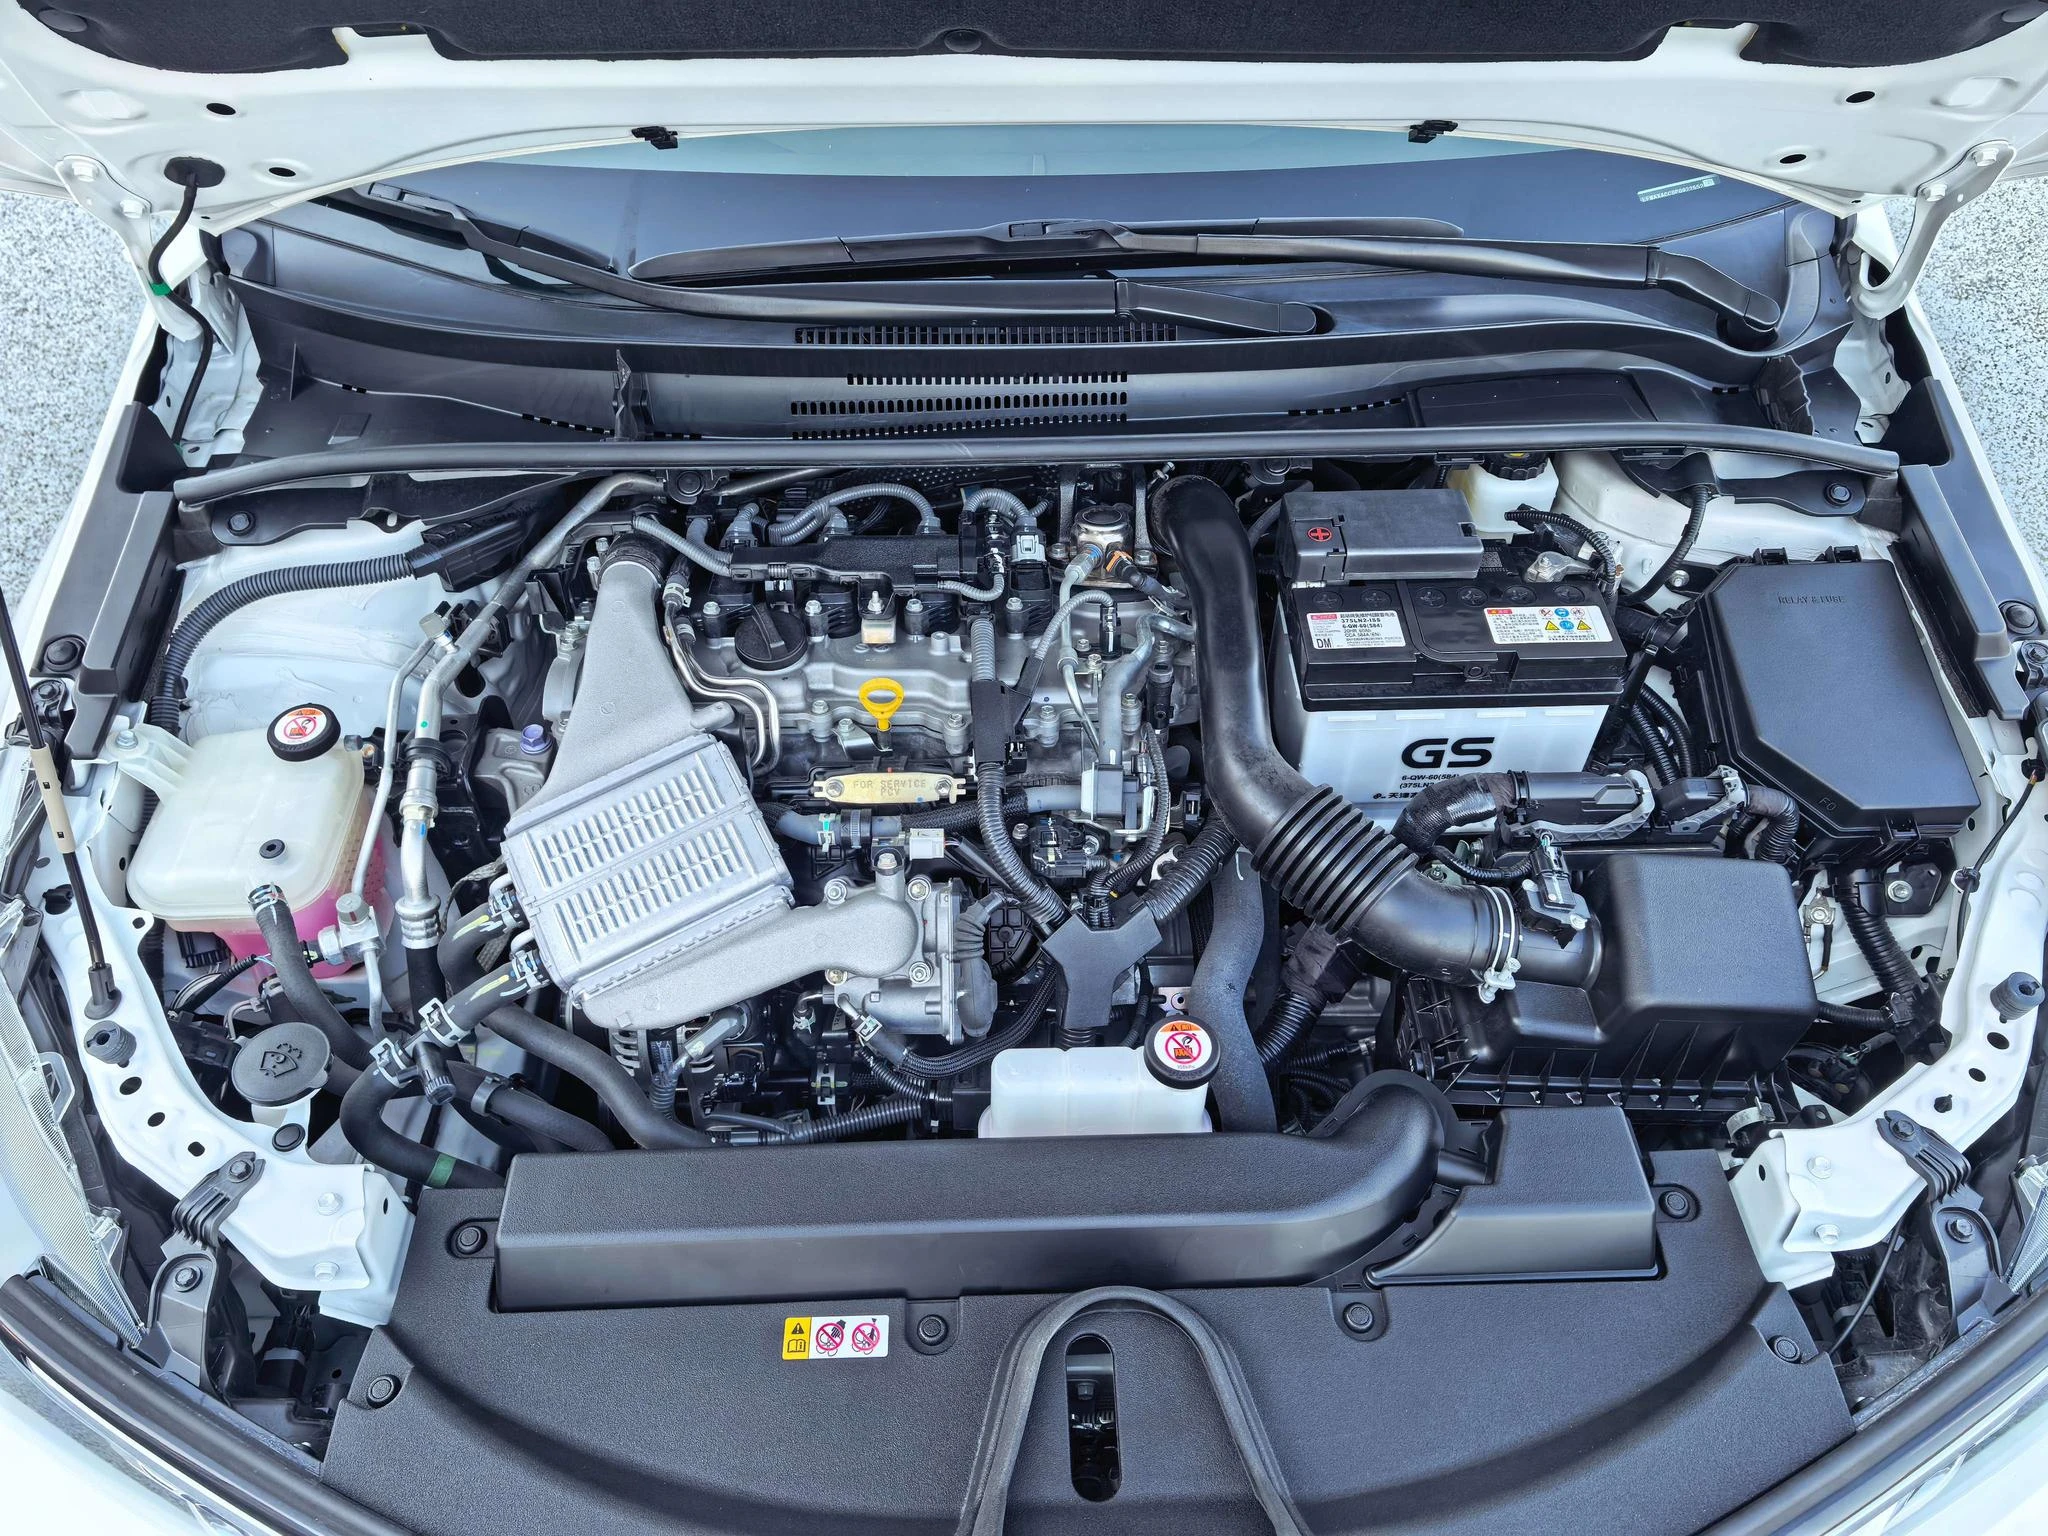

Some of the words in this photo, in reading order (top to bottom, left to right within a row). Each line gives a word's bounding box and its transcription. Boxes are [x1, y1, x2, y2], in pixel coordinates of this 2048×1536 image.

[1316, 638, 1332, 649] DM
[1401, 736, 1495, 769] GS
[853, 780, 873, 789] FOR
[880, 779, 926, 789] SERVICE
[880, 788, 900, 796] PCV
